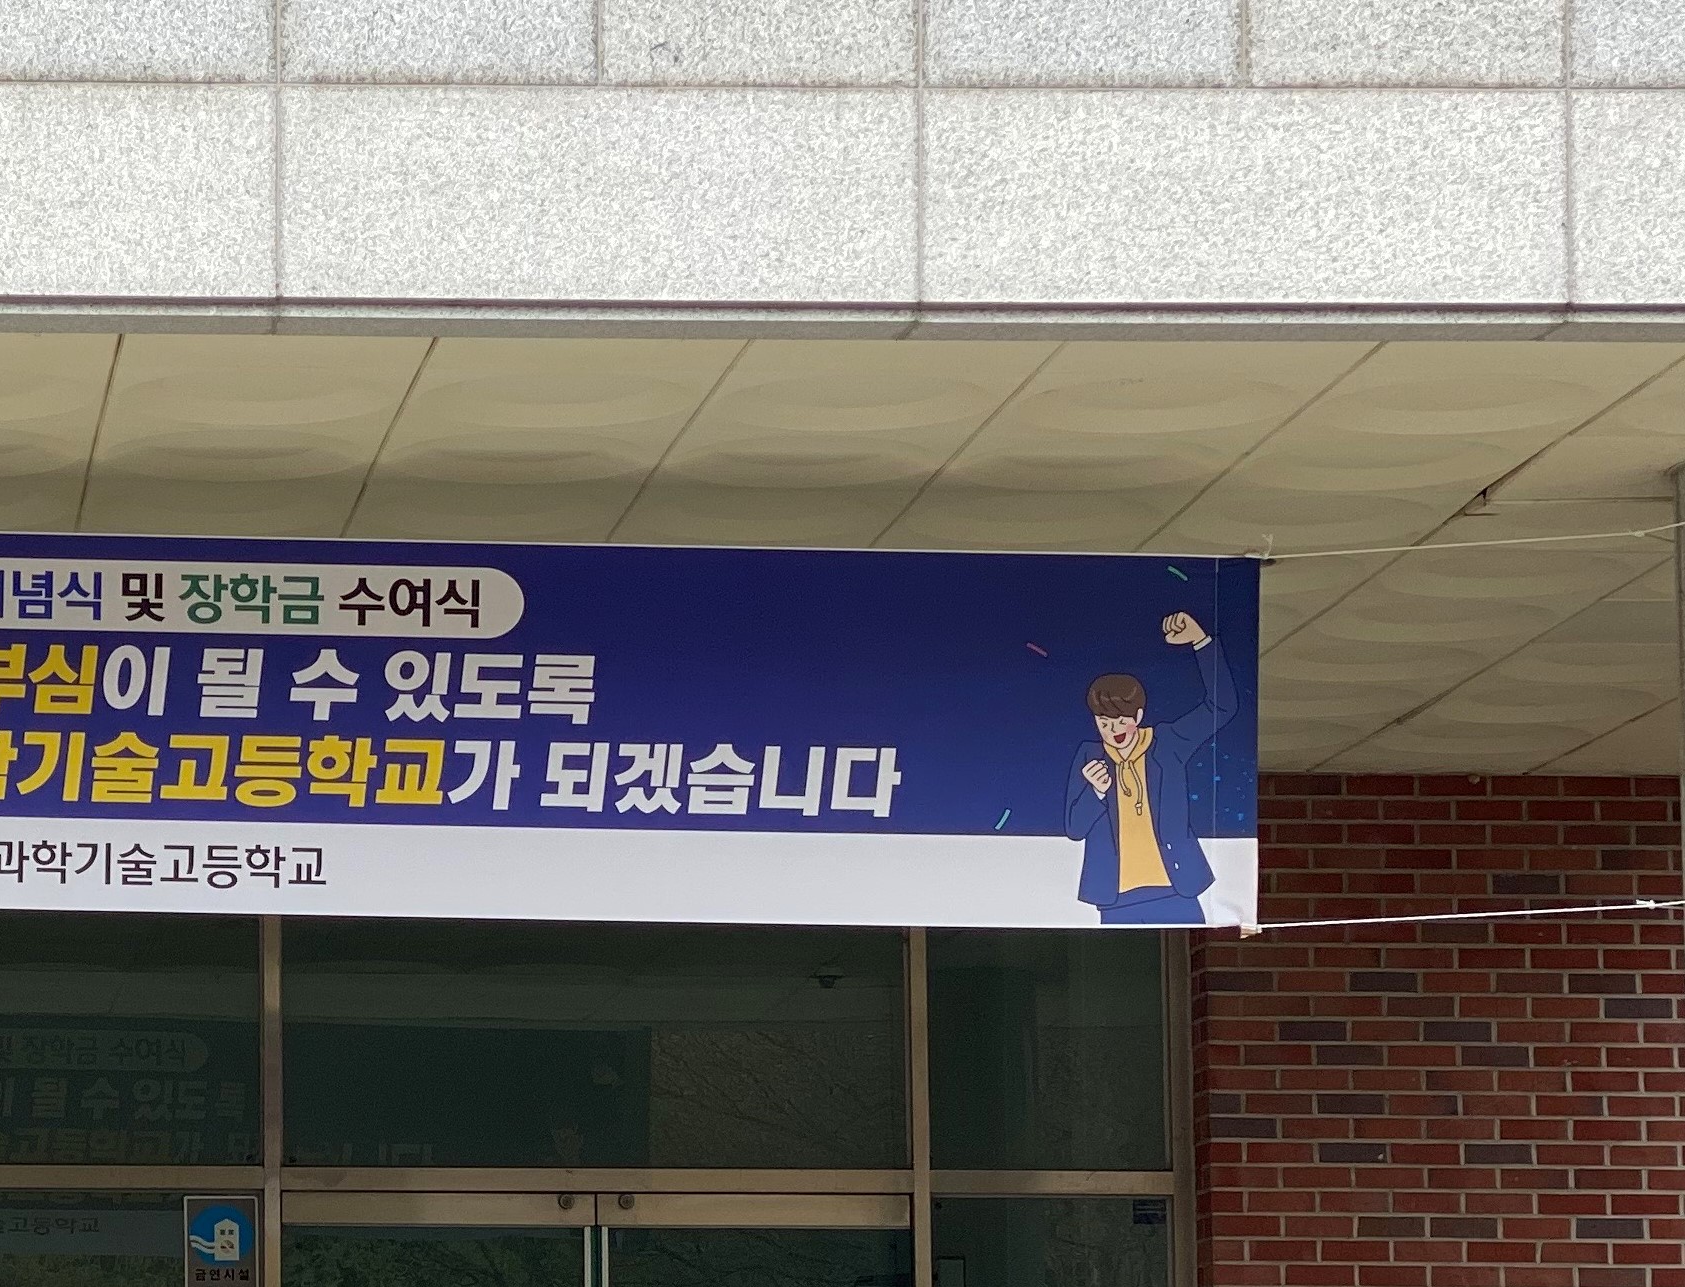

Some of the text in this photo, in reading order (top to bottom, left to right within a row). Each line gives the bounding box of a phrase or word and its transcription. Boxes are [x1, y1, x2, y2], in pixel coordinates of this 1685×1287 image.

[120, 573, 165, 622] 및
[177, 573, 326, 626] 장학금
[338, 577, 481, 628] 수여식
[195, 647, 264, 719] 될
[289, 649, 360, 722] 수
[384, 652, 597, 724] 있도록
[538, 740, 902, 818] 되겠습니다
[196, 1268, 249, 1281] 금연시설
